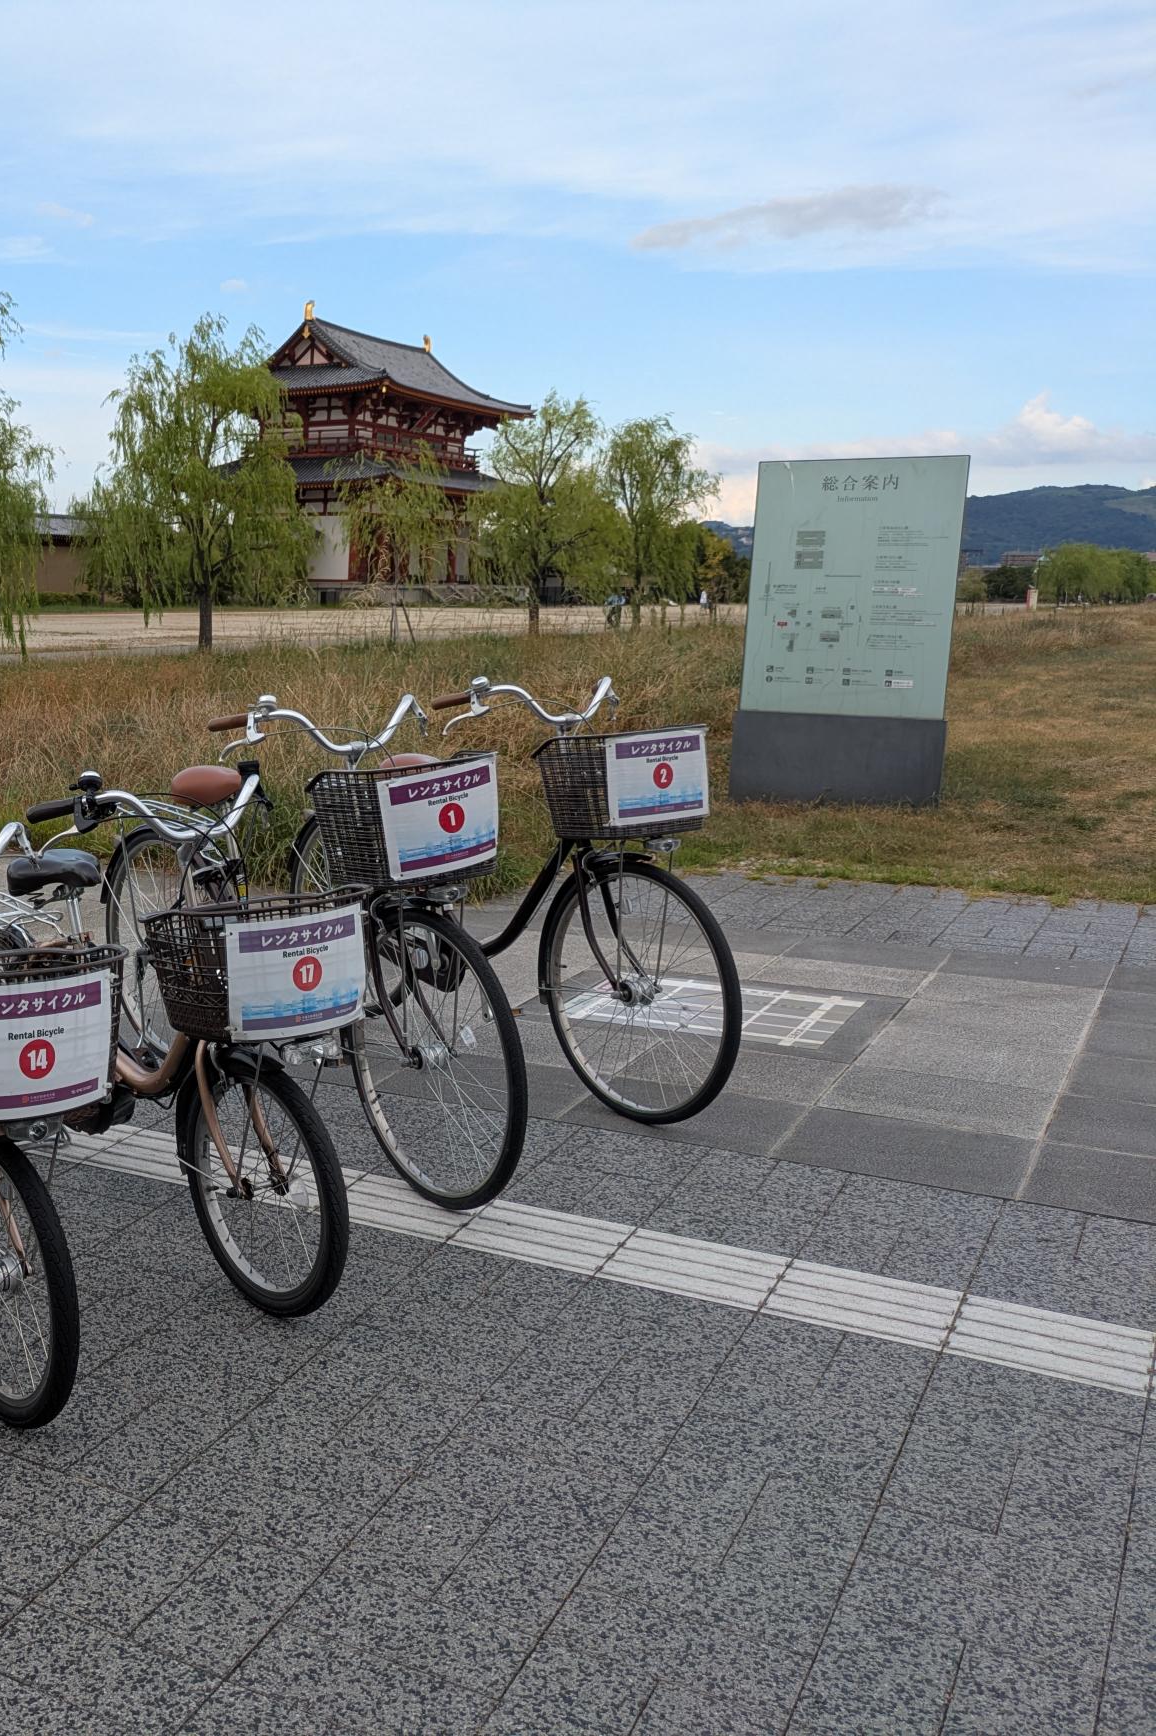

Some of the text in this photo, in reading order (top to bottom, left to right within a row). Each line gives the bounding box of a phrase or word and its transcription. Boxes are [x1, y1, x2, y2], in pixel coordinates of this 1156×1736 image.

[822, 473, 899, 491] 総合案内
[837, 495, 878, 503] Information
[631, 740, 692, 756] レンタサイクル
[662, 754, 679, 762] Bicycle
[660, 768, 668, 784] 2
[408, 773, 481, 799] レンタサイクル
[428, 792, 469, 807] Rental Bicycle
[447, 809, 456, 827] 1
[261, 923, 344, 947] レンタサイクル
[282, 944, 329, 959] Rental Bicycle
[299, 963, 315, 984] 17
[8, 1026, 65, 1041] Rental Bicycle
[27, 1048, 48, 1071] 14
